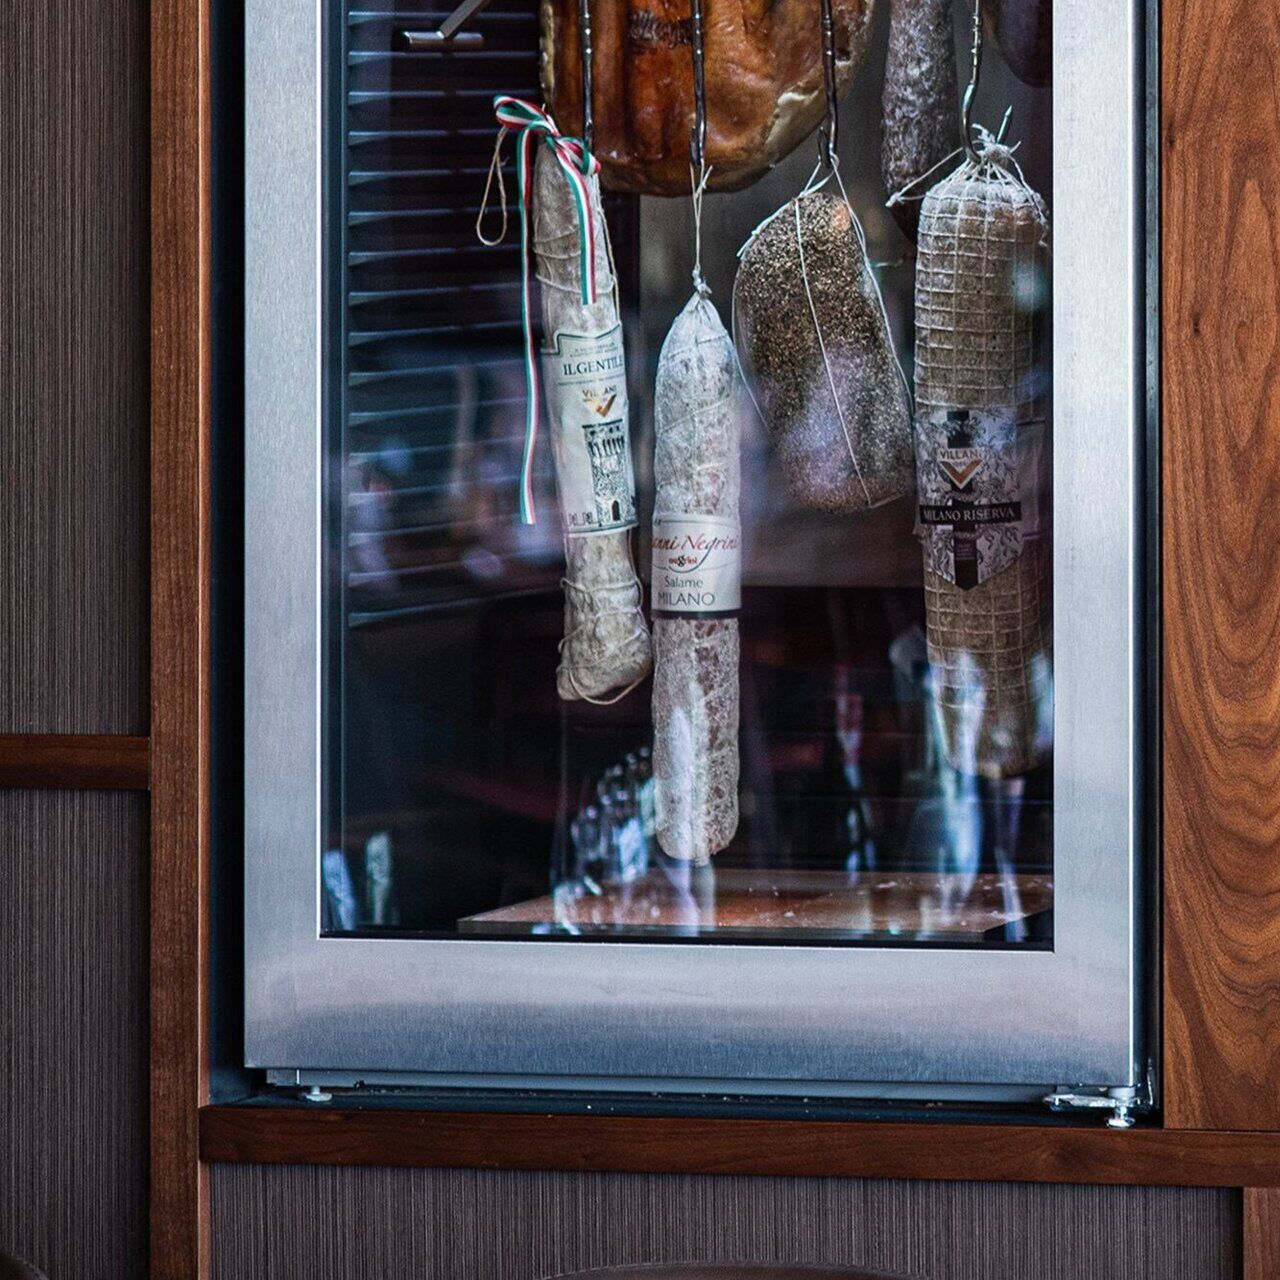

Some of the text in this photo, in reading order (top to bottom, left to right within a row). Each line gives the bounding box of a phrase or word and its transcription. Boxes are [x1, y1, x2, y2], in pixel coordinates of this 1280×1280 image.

[923, 506, 1015, 521] MILANO RISERVA
[664, 576, 703, 588] Salame
[657, 592, 715, 606] MILANO
